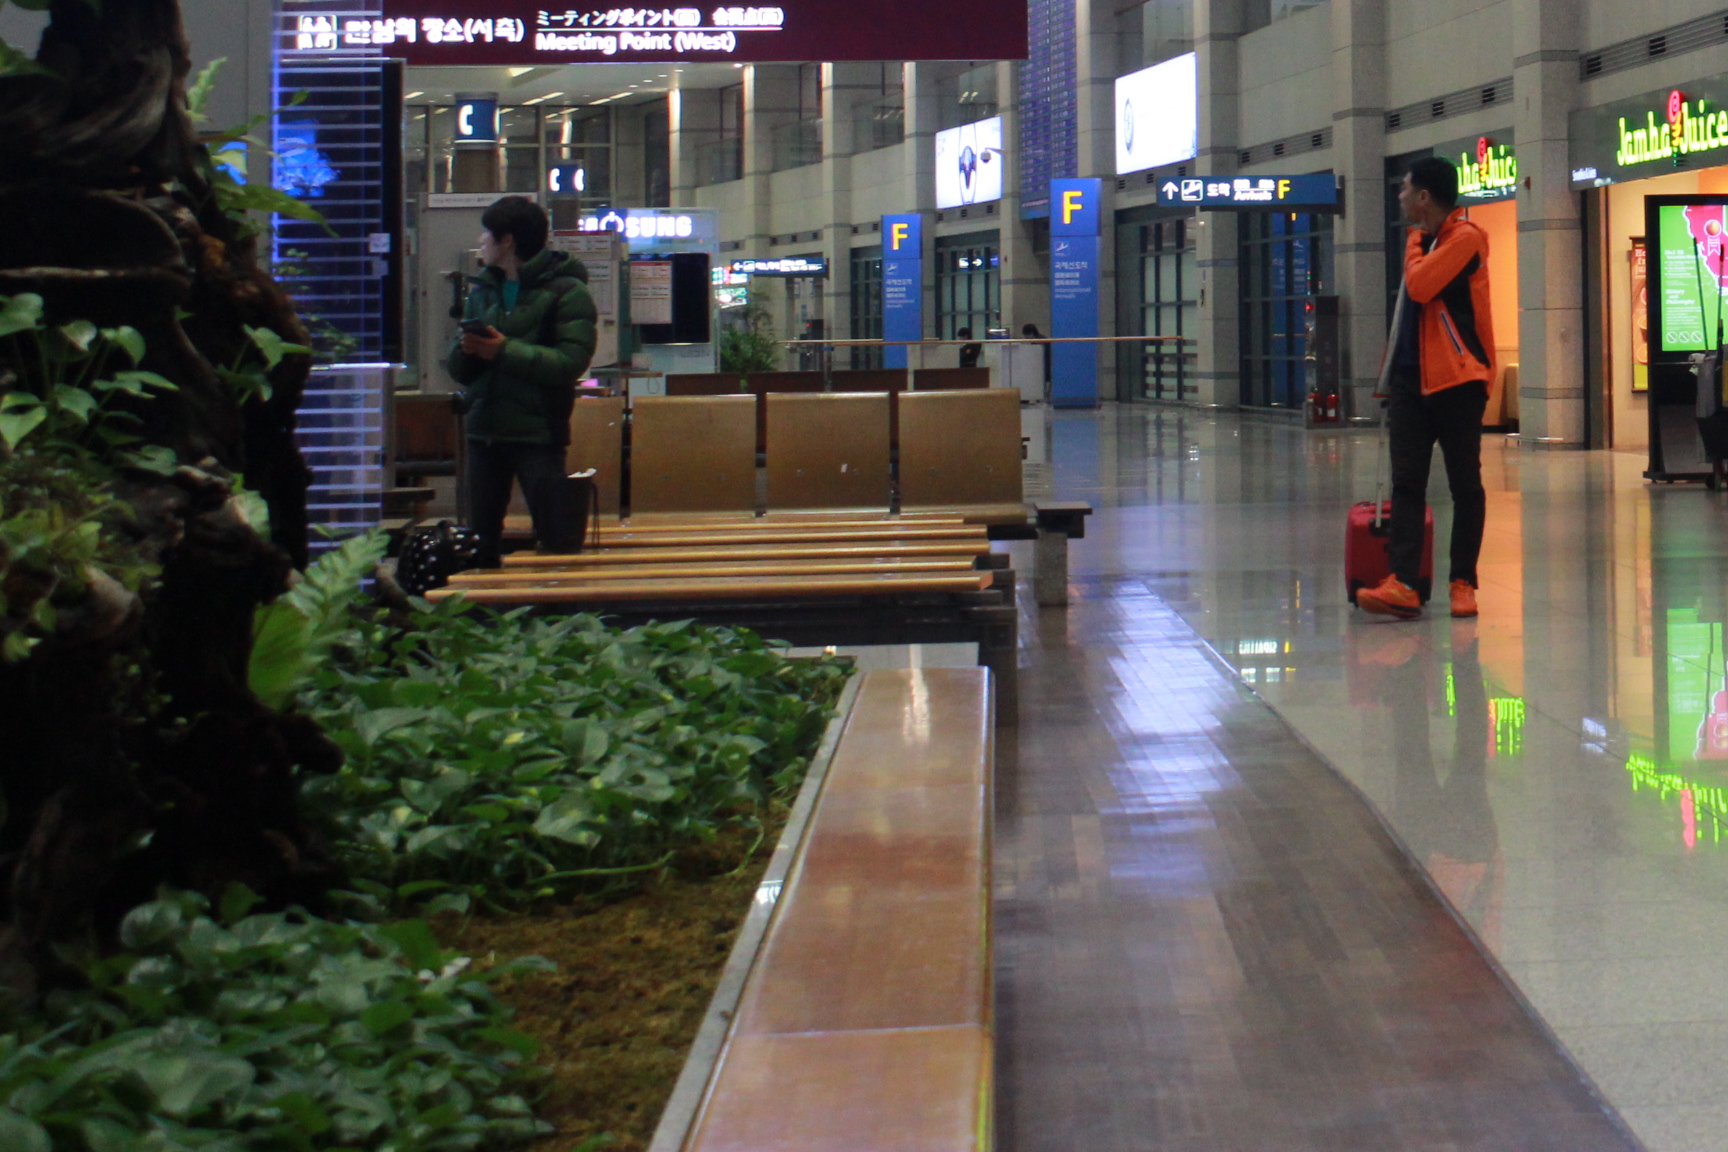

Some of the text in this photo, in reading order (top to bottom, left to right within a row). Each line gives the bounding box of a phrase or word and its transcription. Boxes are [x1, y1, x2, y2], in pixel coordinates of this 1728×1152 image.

[344, 17, 525, 44] 만남의 장소(서측)
[535, 31, 737, 55] Meeting Point (West)
[1616, 111, 1673, 167] Jamba
[1206, 183, 1231, 197] 도착
[1278, 179, 1291, 200] F
[1062, 191, 1083, 225] F
[578, 215, 693, 238] ASUNG
[892, 223, 908, 251] F
